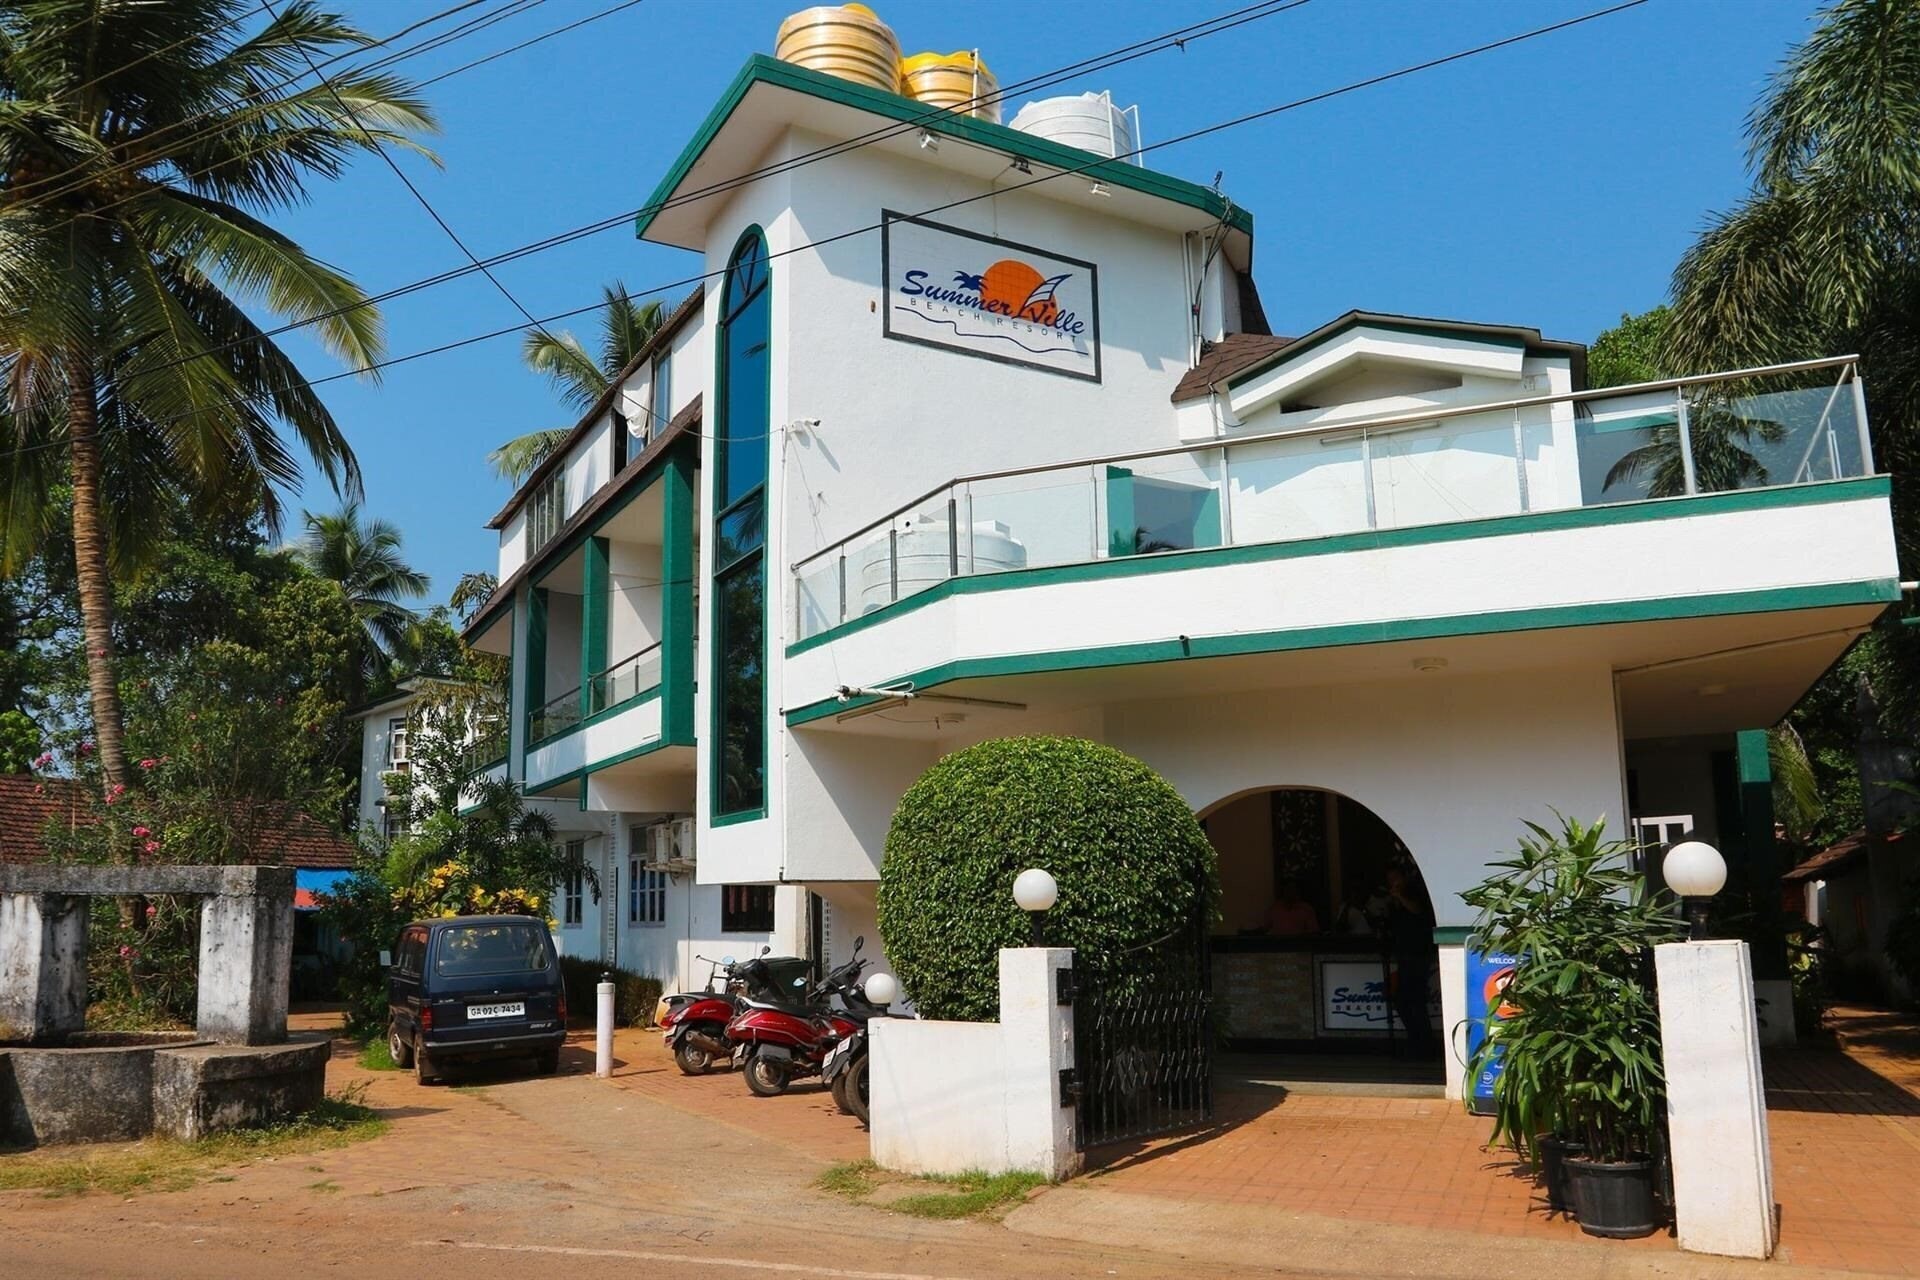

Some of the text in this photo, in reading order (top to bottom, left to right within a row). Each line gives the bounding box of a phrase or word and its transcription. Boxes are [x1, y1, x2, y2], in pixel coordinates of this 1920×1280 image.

[900, 270, 1014, 316] Summer
[911, 298, 1077, 343] BEACH RESORT
[1332, 987, 1386, 1003] Summ
